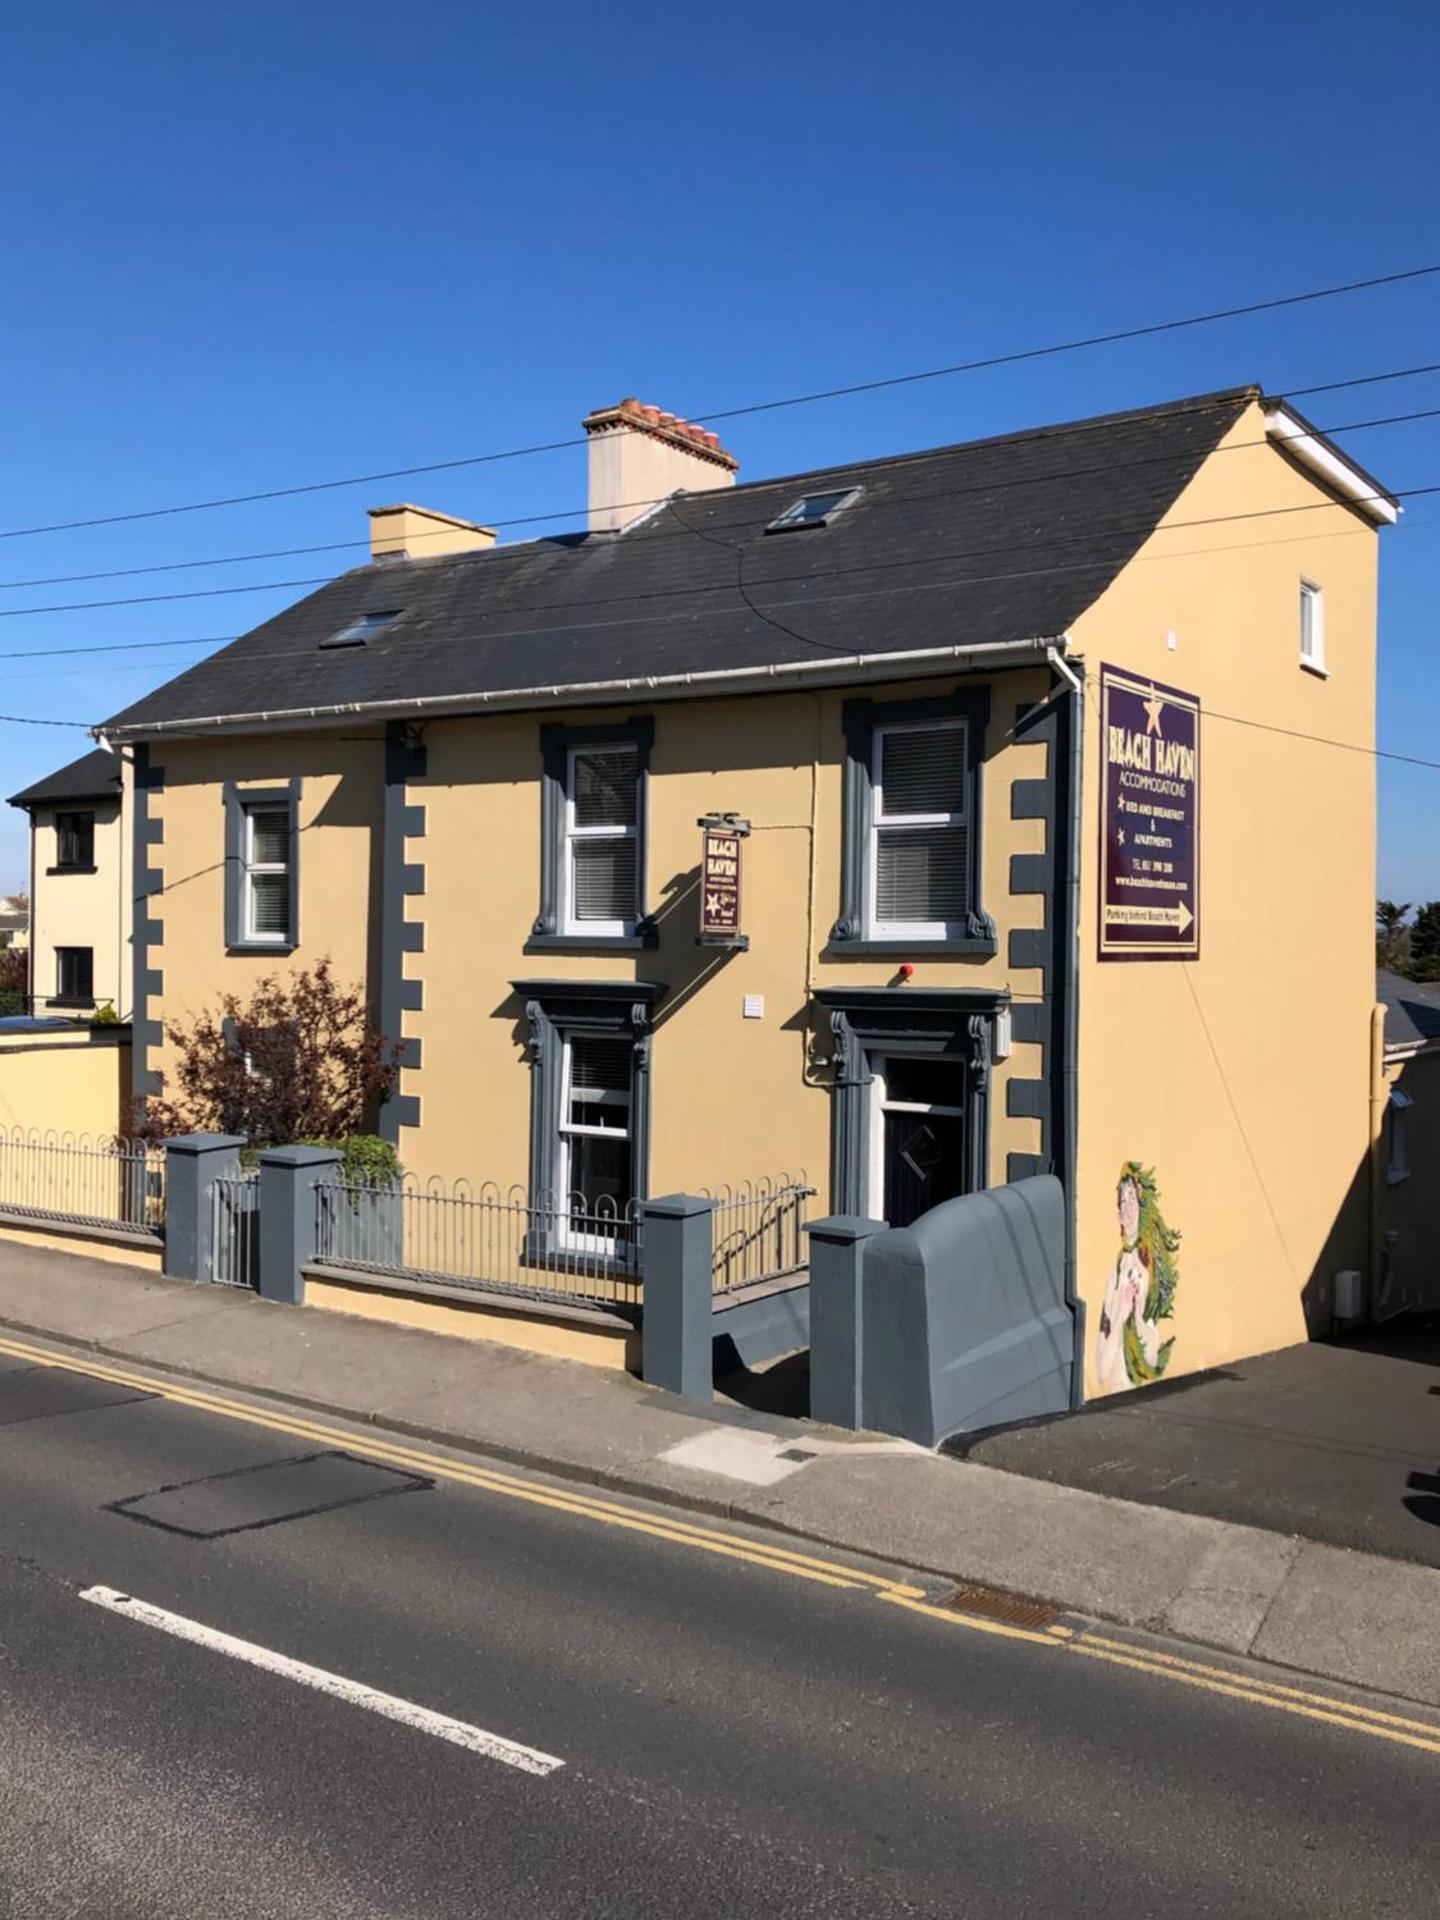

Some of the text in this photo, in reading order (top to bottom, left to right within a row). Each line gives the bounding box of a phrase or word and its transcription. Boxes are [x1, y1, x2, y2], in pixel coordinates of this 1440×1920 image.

[1109, 726, 1194, 782] BEACH HAVEN
[1120, 771, 1185, 797] ACCOMMODATIONS
[1126, 801, 1184, 820] BED AND BREAKFAST
[708, 839, 737, 857] BEACH
[1135, 834, 1172, 848] APARTMENTS
[707, 858, 736, 876] HAVEN
[1107, 908, 1180, 922] Parking behind Beach Haven
